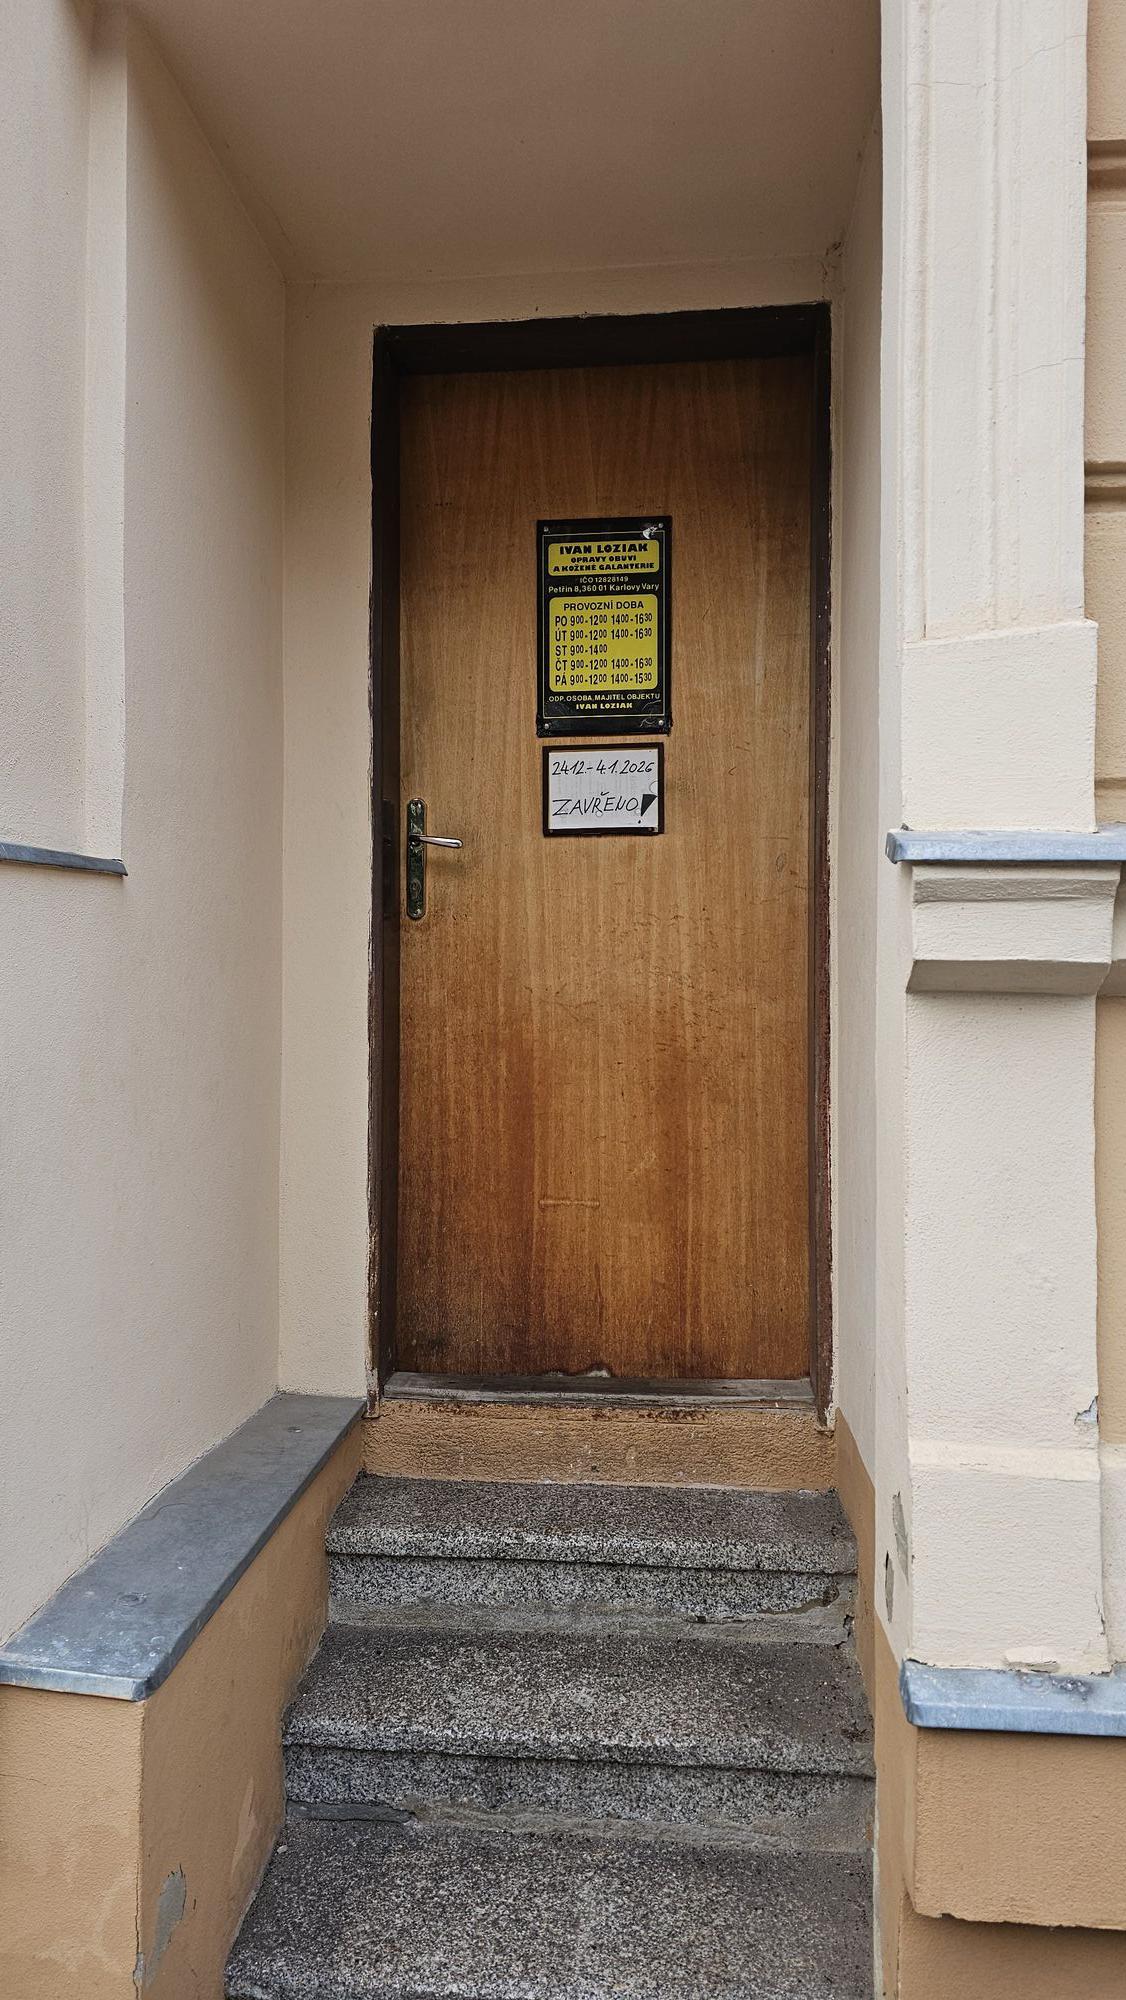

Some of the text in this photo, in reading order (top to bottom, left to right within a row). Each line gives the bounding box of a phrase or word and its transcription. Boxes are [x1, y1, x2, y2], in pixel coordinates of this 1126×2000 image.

[560, 543, 648, 555] IVAN LOZIAK
[599, 562, 654, 570] GALANTERIE
[609, 583, 640, 592] Karlovy
[641, 582, 660, 591] Vary
[563, 600, 644, 611] PROVOZNÍ DOBA
[555, 616, 568, 627] PO
[555, 628, 567, 641] ÚT
[555, 645, 567, 656] ST
[555, 658, 567, 671] ČT
[555, 672, 567, 686] PÁ
[626, 692, 660, 700] OBJEKTU
